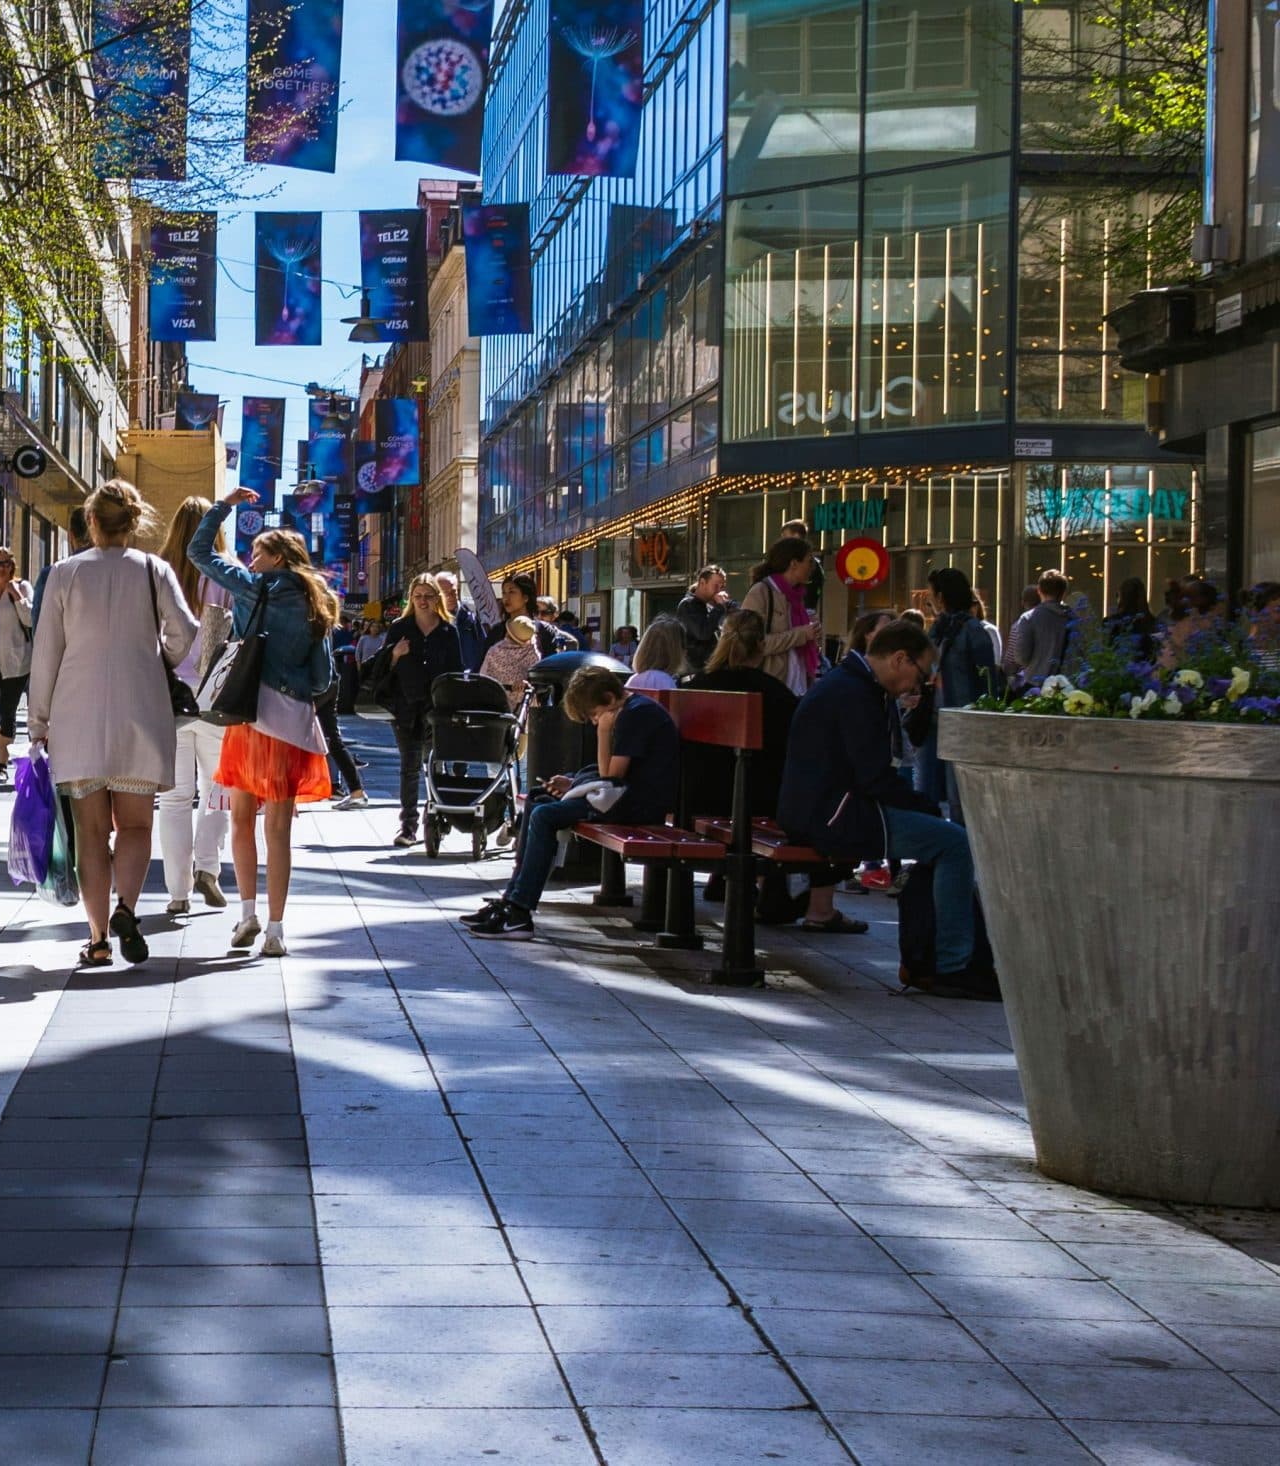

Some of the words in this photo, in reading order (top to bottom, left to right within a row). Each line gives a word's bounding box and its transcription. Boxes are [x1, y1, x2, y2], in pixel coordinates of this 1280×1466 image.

[273, 67, 312, 79] COME
[256, 79, 330, 93] TOGETHER
[168, 229, 199, 242] TELE2
[377, 229, 409, 242] TELE2
[172, 319, 196, 329] VISA
[385, 320, 409, 329] VISA
[814, 499, 885, 531] WEEKDAY
[637, 529, 669, 574] MQ
